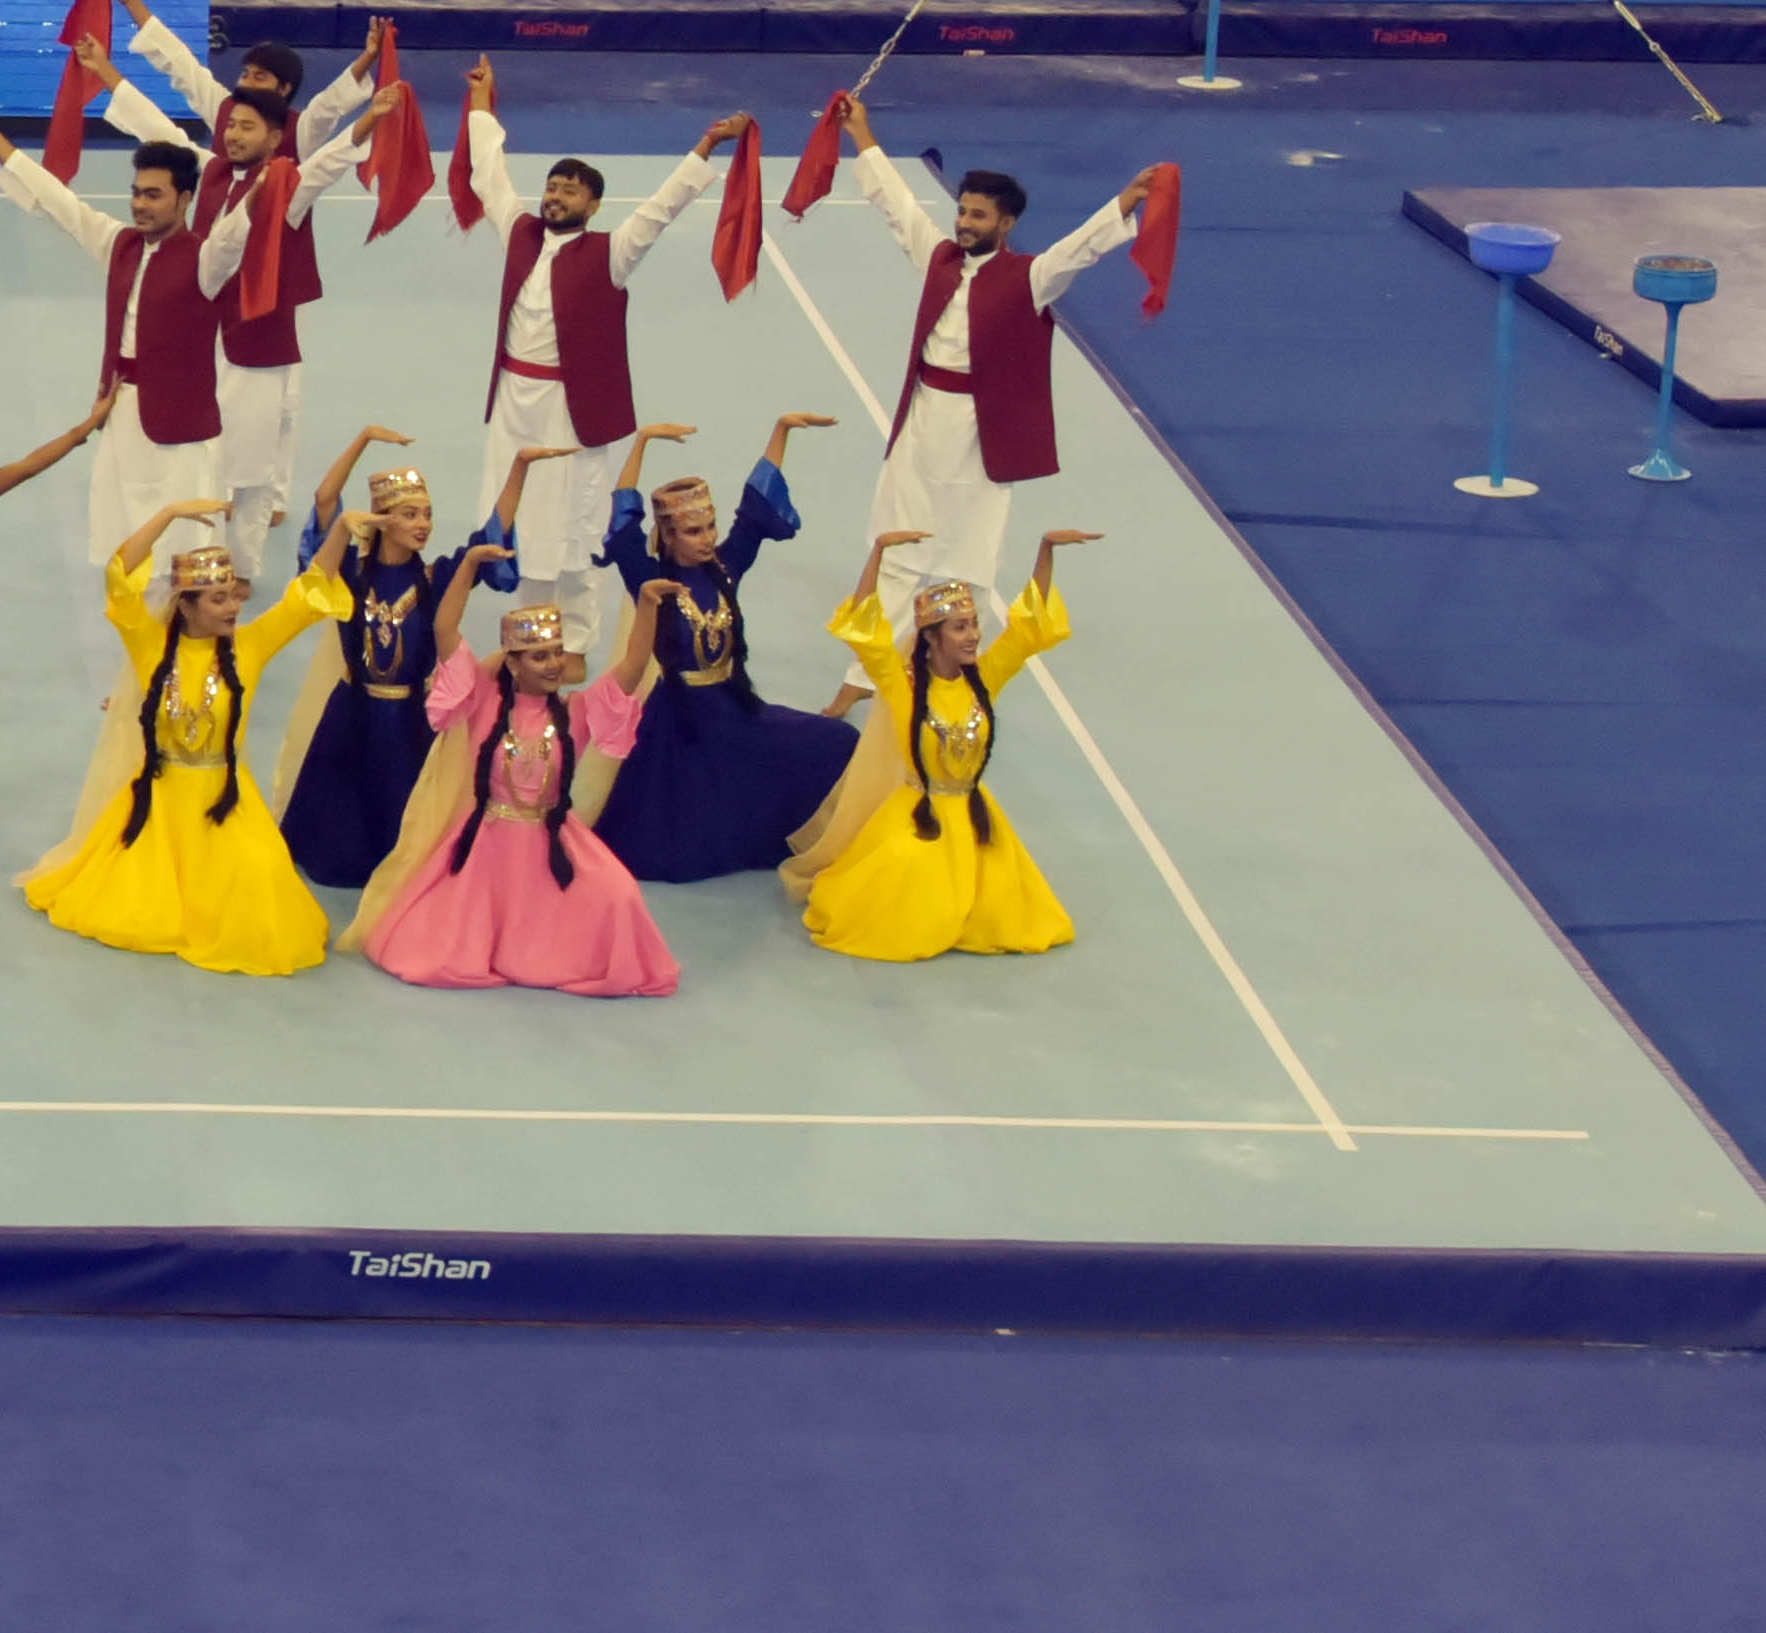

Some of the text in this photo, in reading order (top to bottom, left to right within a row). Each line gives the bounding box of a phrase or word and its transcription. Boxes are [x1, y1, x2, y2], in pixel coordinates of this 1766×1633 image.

[514, 20, 589, 36] TaiShan
[940, 26, 1014, 42] TaiShan
[1373, 28, 1447, 44] TaiShan
[349, 1249, 491, 1280] TaiShan
